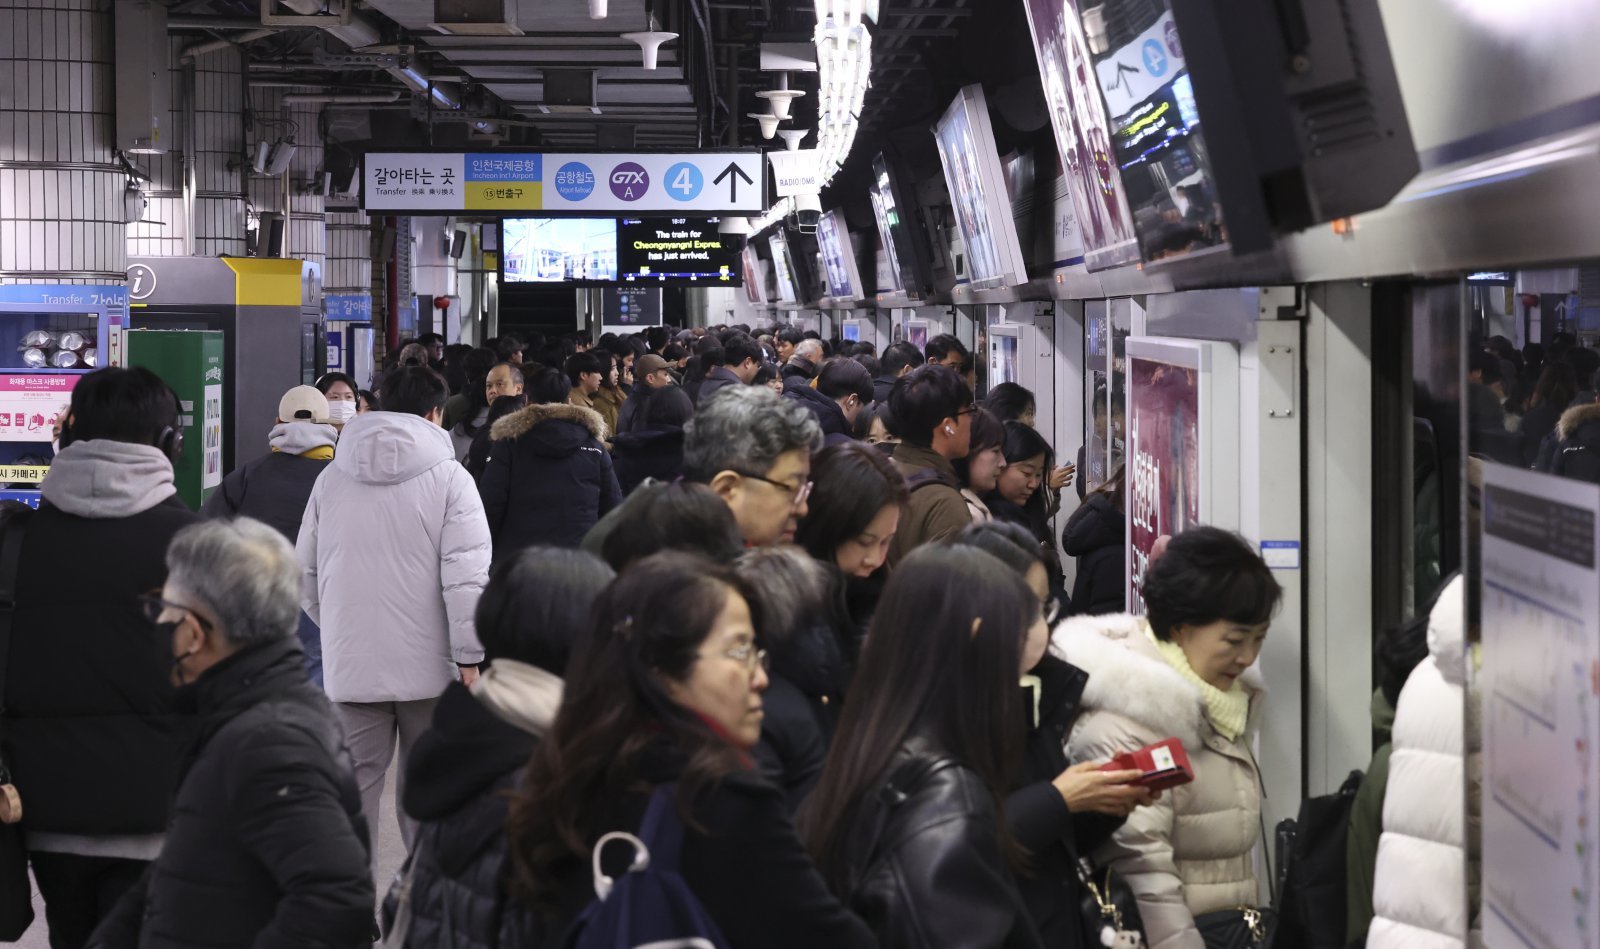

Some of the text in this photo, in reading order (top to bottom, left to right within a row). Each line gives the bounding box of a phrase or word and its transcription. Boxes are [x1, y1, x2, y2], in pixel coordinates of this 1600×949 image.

[472, 159, 535, 172] 인천국제공항
[374, 168, 455, 185] 갈아타는 곳
[512, 172, 534, 180] Airport
[557, 171, 594, 184] 공항철도
[612, 171, 645, 184] GTX
[671, 167, 693, 195] 4
[375, 187, 407, 196] Transfer
[496, 188, 523, 199] 번출구
[624, 186, 634, 198] A
[656, 230, 702, 239] The train for
[633, 240, 692, 250] Cheongnyangni
[648, 251, 710, 261] has just arrived.
[42, 293, 83, 304] Transfer
[9, 377, 66, 386] 화재용 마스크 사용방법
[11, 469, 38, 479] 카메라
